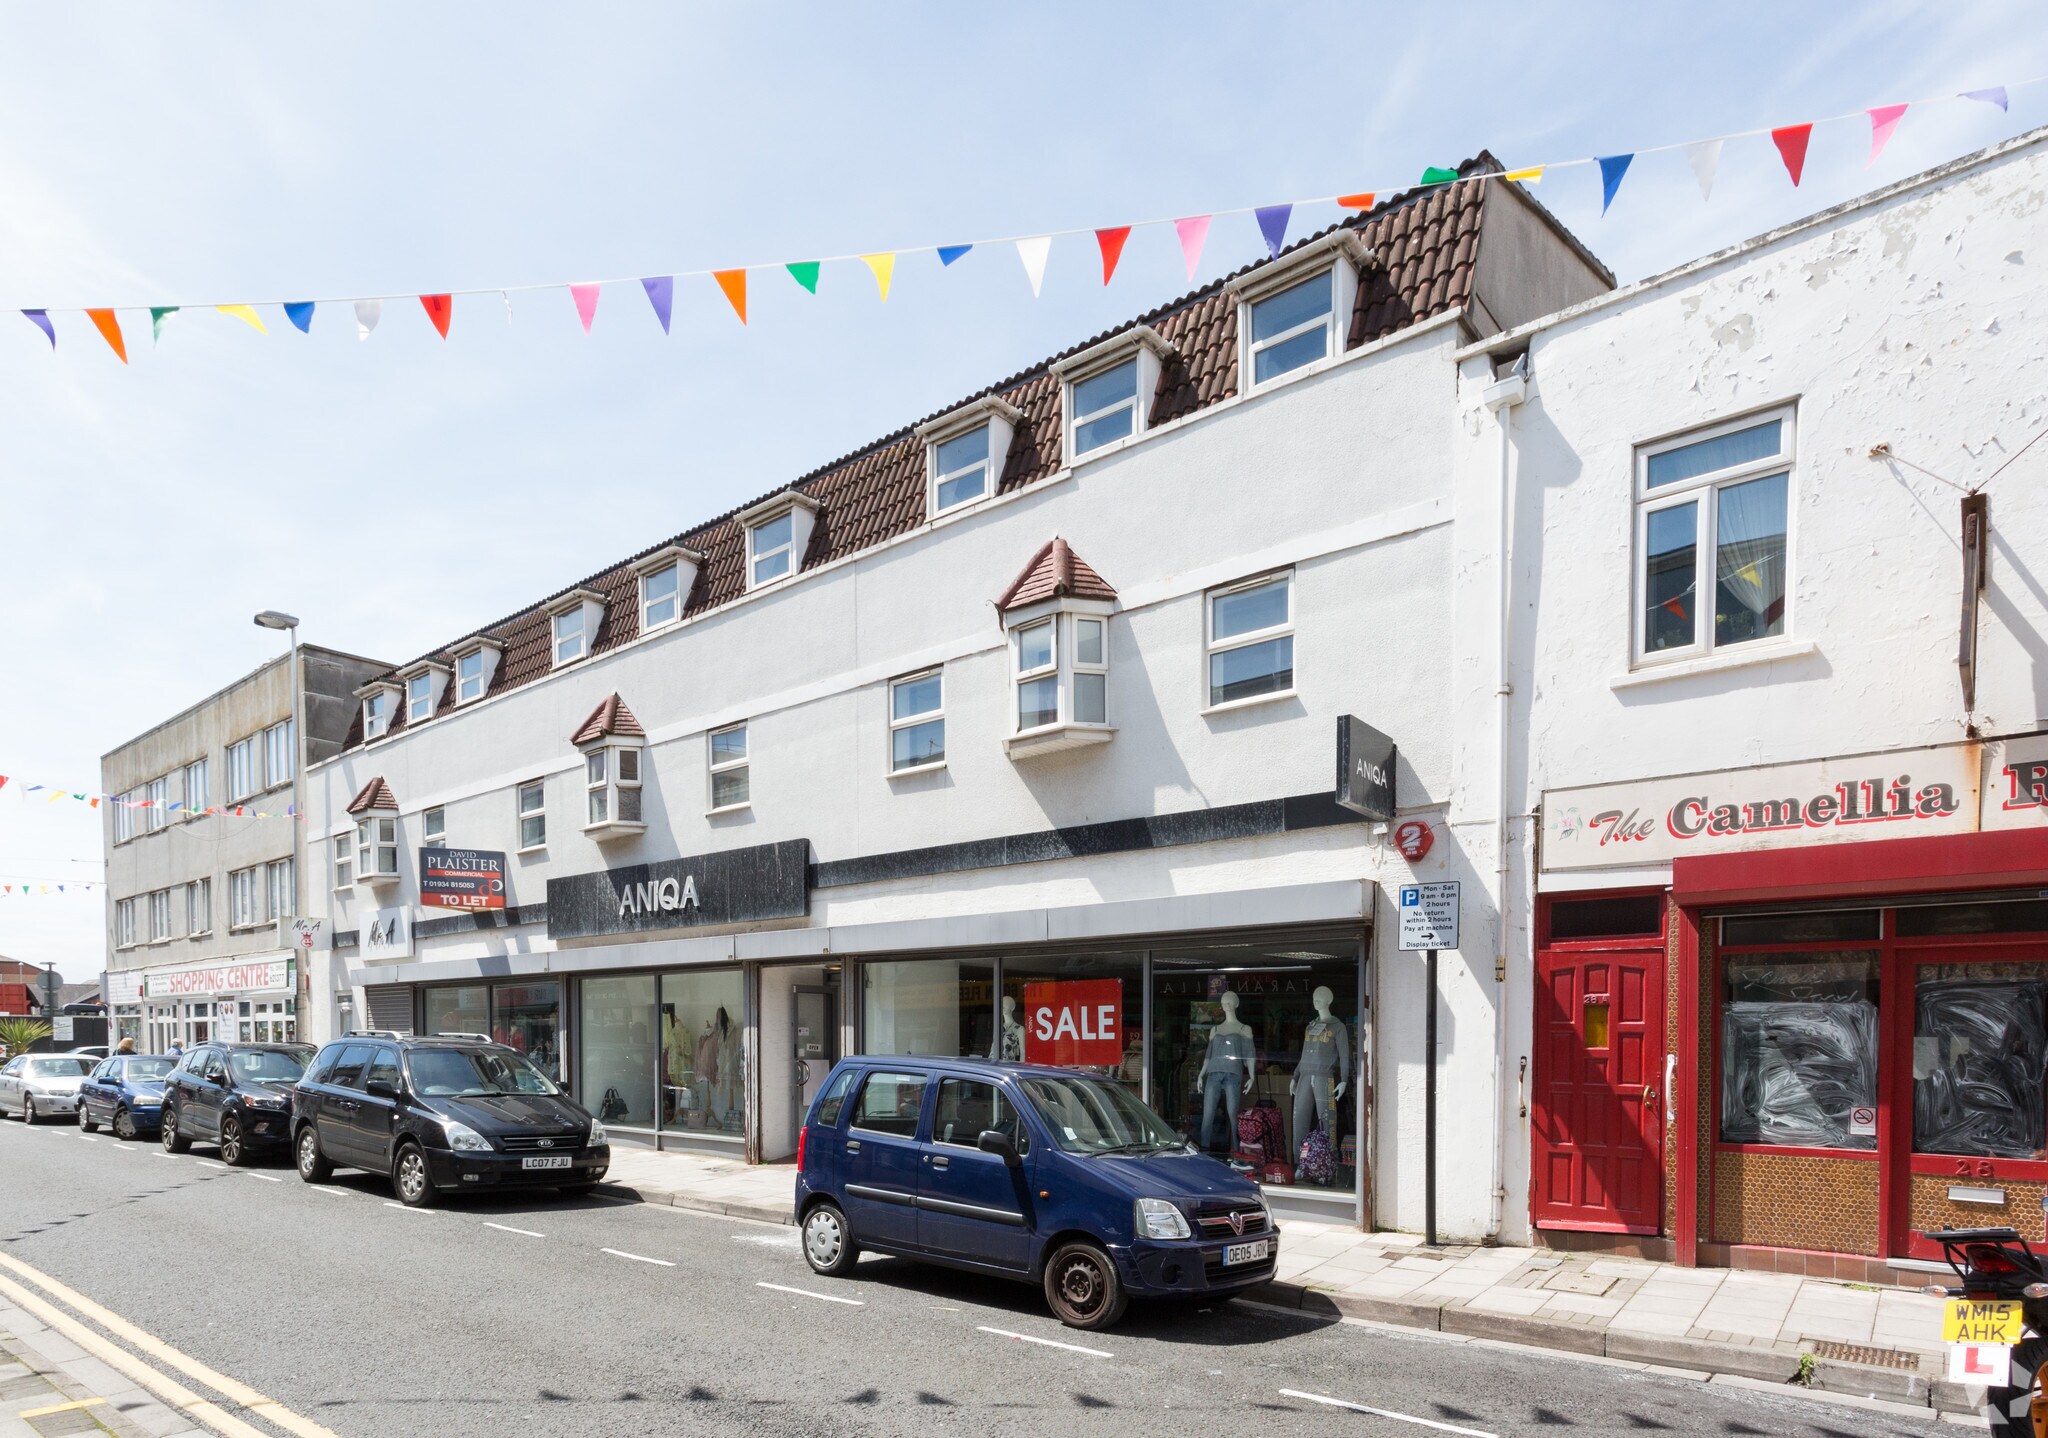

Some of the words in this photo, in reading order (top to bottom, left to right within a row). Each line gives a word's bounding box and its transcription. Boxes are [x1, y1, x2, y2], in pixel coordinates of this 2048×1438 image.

[1356, 757, 1388, 789] ANIQA
[1588, 806, 1657, 847] The
[1666, 772, 1961, 840] Camellia
[449, 850, 477, 859] DAVID
[427, 856, 500, 872] PLAISTER
[444, 870, 485, 878] COMMERCIAL
[429, 880, 450, 888] 01934
[450, 881, 475, 889] 815053
[440, 894, 460, 906] TO
[462, 895, 488, 907] LET
[619, 875, 700, 917] ANIQA
[1405, 890, 1416, 905] P
[312, 920, 322, 931] A
[385, 917, 396, 945] A
[169, 968, 223, 993] SHOPPING
[227, 962, 269, 989] CENTRE
[1035, 1005, 1116, 1041] SALE
[525, 1158, 550, 1168] LC07
[551, 1158, 569, 1167] FJU
[1955, 1159, 1993, 1178] 28
[1229, 1246, 1252, 1262] OE05
[1956, 1303, 2012, 1321] WM15
[1957, 1323, 2006, 1341] AHK
[1964, 1347, 1994, 1374] L
